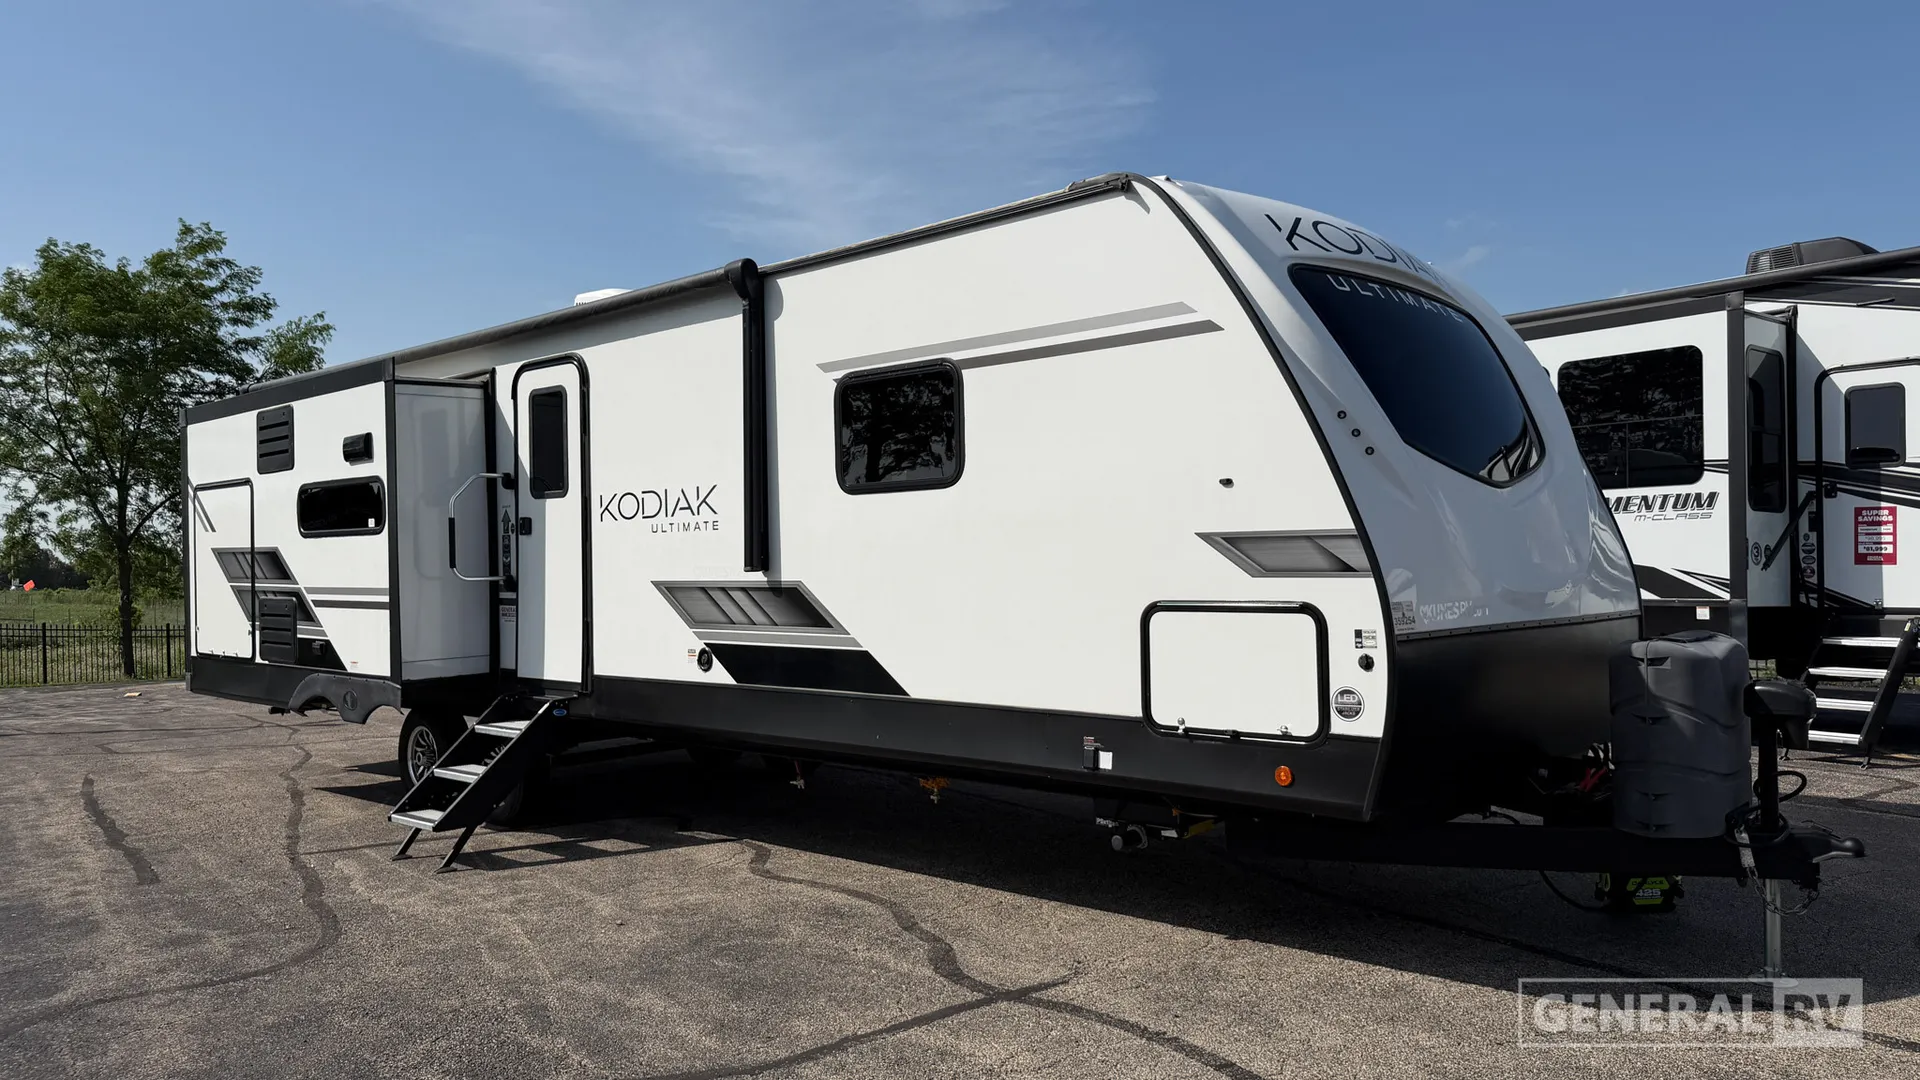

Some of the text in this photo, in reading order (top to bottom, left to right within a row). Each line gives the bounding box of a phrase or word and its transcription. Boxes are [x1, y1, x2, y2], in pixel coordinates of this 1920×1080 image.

[1326, 273, 1464, 323] ULTIMATE
[600, 484, 718, 522] KODIAK
[651, 520, 719, 534] ULTIMATE
[1337, 693, 1358, 703] LED
[1636, 888, 1661, 896] 425
